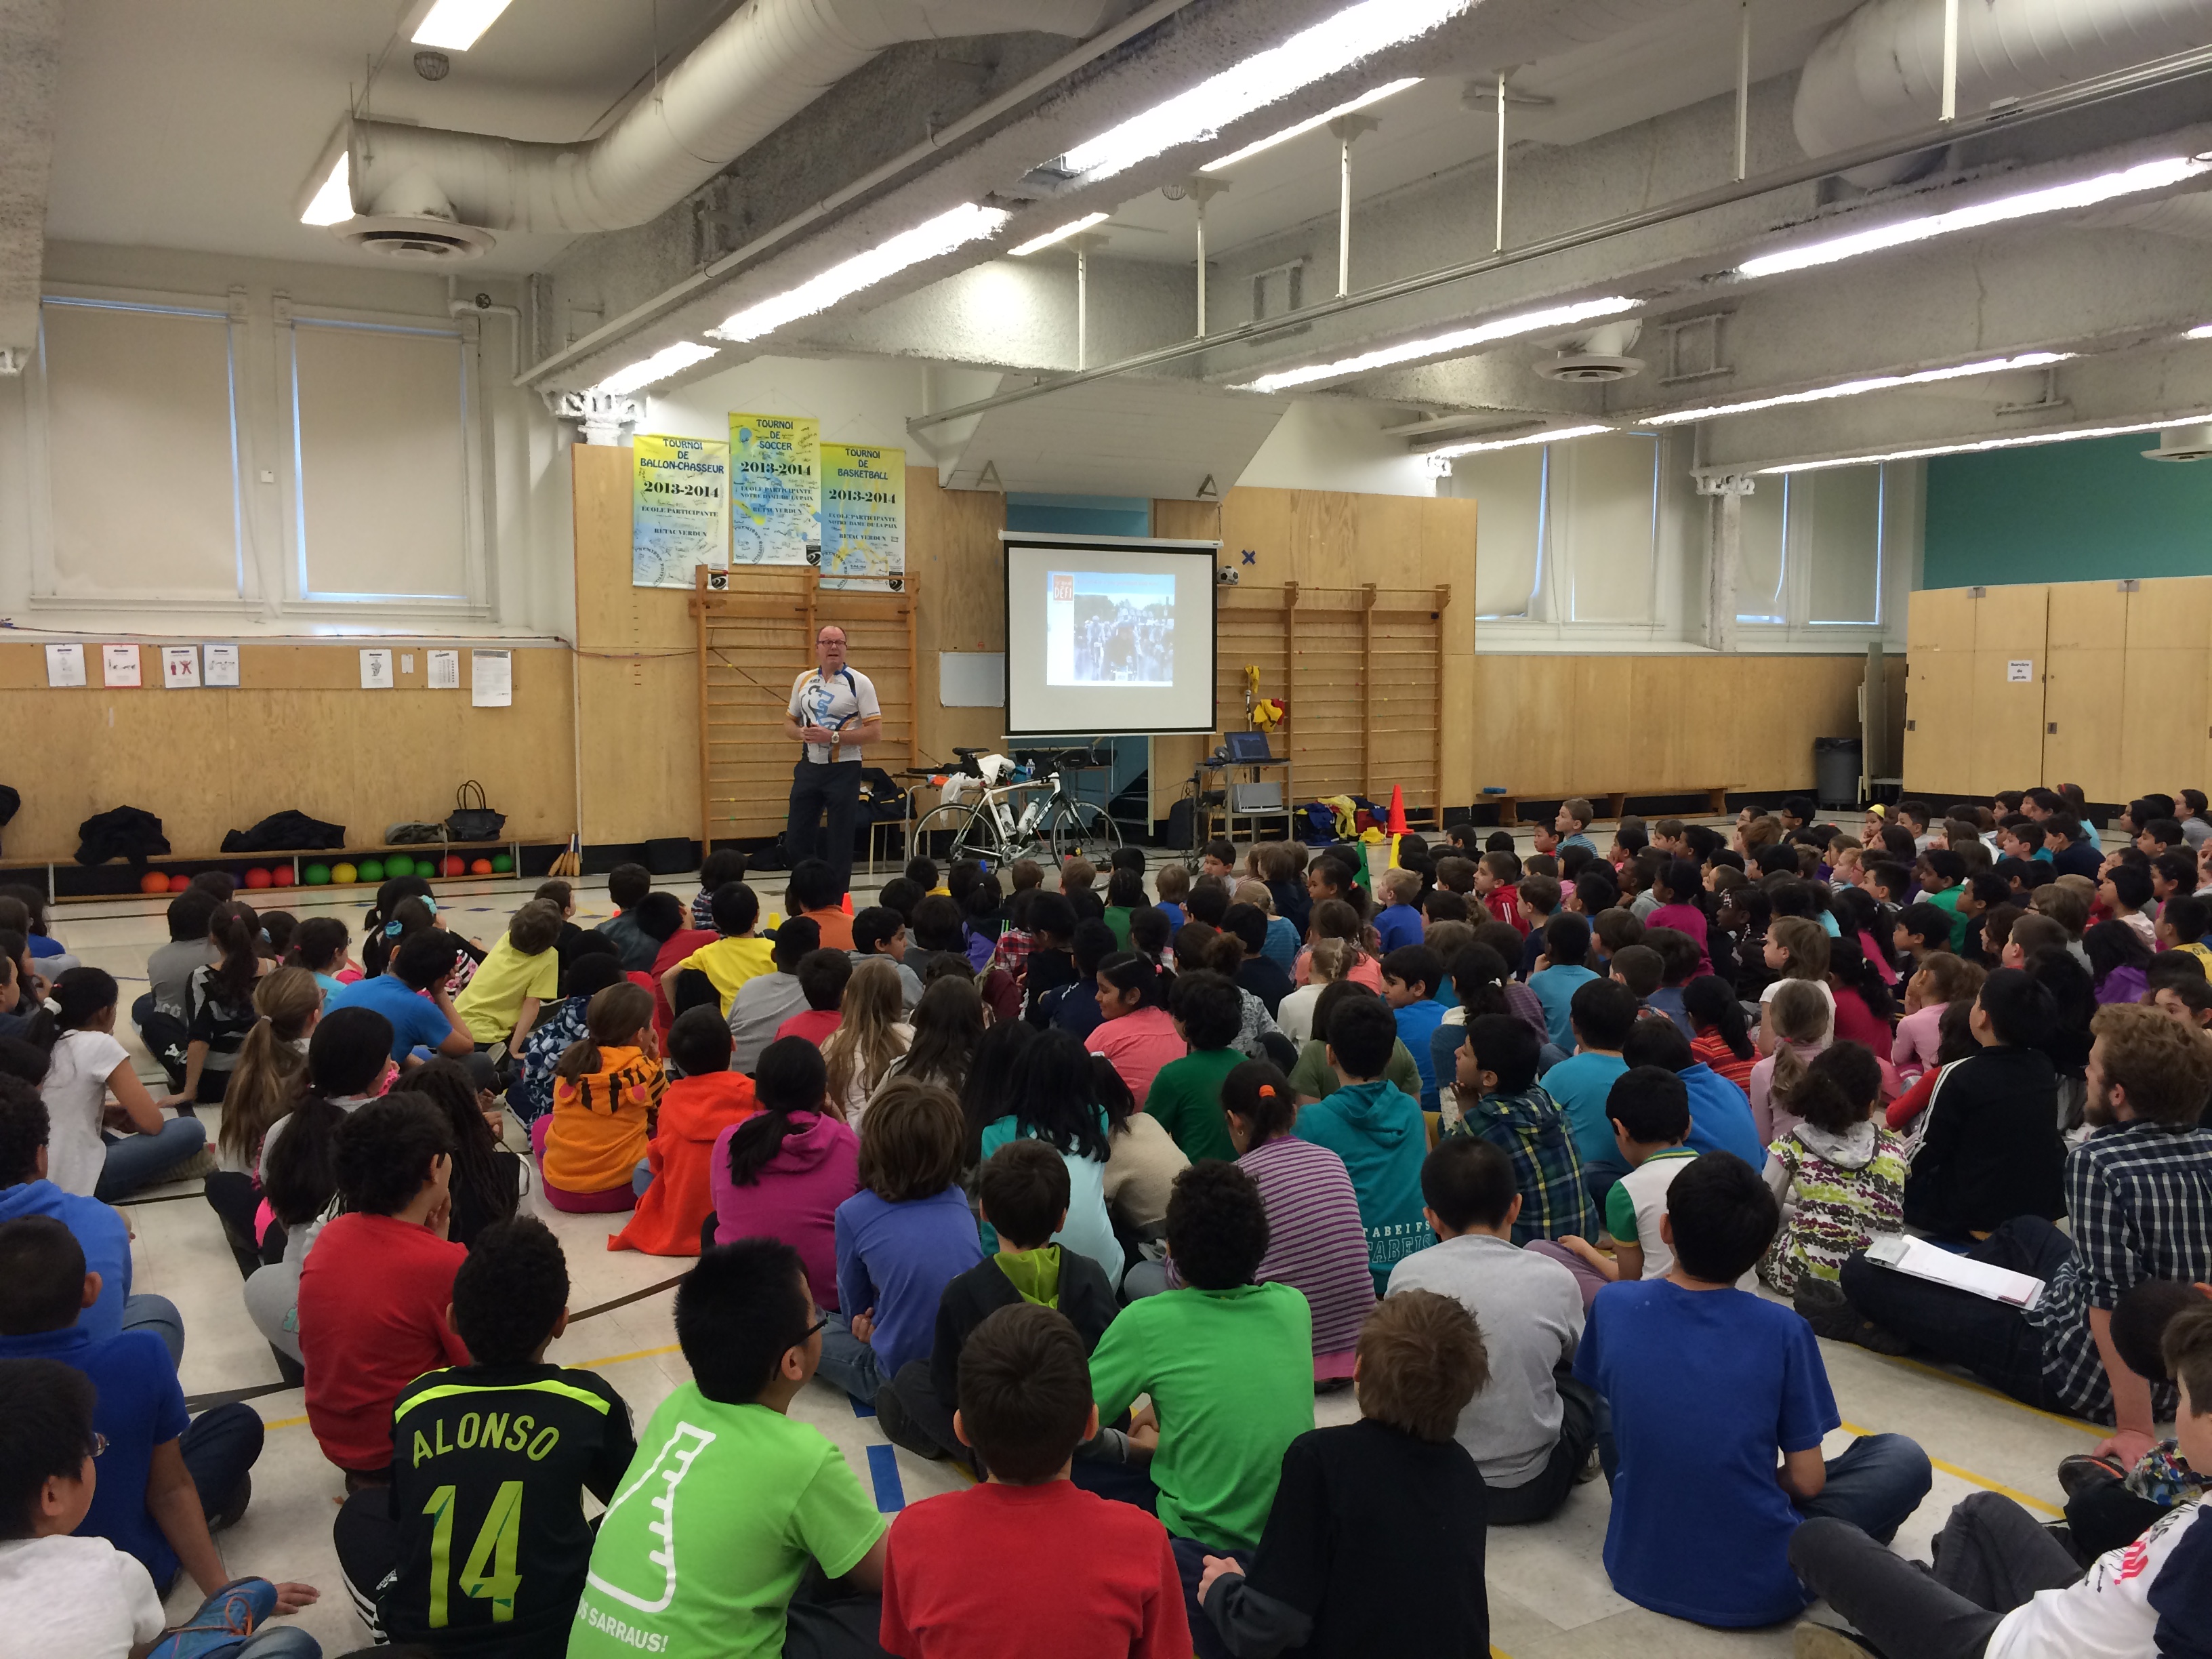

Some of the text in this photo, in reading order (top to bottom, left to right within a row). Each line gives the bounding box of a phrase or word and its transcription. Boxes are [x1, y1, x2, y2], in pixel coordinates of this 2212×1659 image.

[756, 419, 794, 430] TOURNOI
[770, 430, 781, 439] DE
[663, 438, 703, 450] TOURNOI
[759, 441, 792, 451] SOCCER
[678, 451, 689, 459] DE
[845, 448, 880, 459] TOURNOI
[640, 457, 724, 474] BALLON-CHASSEUR
[741, 462, 811, 476] 2013-2014
[858, 459, 869, 468] DE
[838, 468, 888, 480] BASKETBALL
[643, 480, 719, 498] 2013-2014
[764, 487, 813, 495] PARTICIPANTE
[829, 489, 896, 504] 2013-2014
[667, 508, 718, 517] PARTICIPANTE
[851, 514, 897, 523] PARTICIPANTE
[1027, 800, 1053, 836] TREK
[413, 1412, 560, 1469] ALONSO
[422, 1480, 523, 1629] 14
[588, 1607, 670, 1653] SARRAUS!
